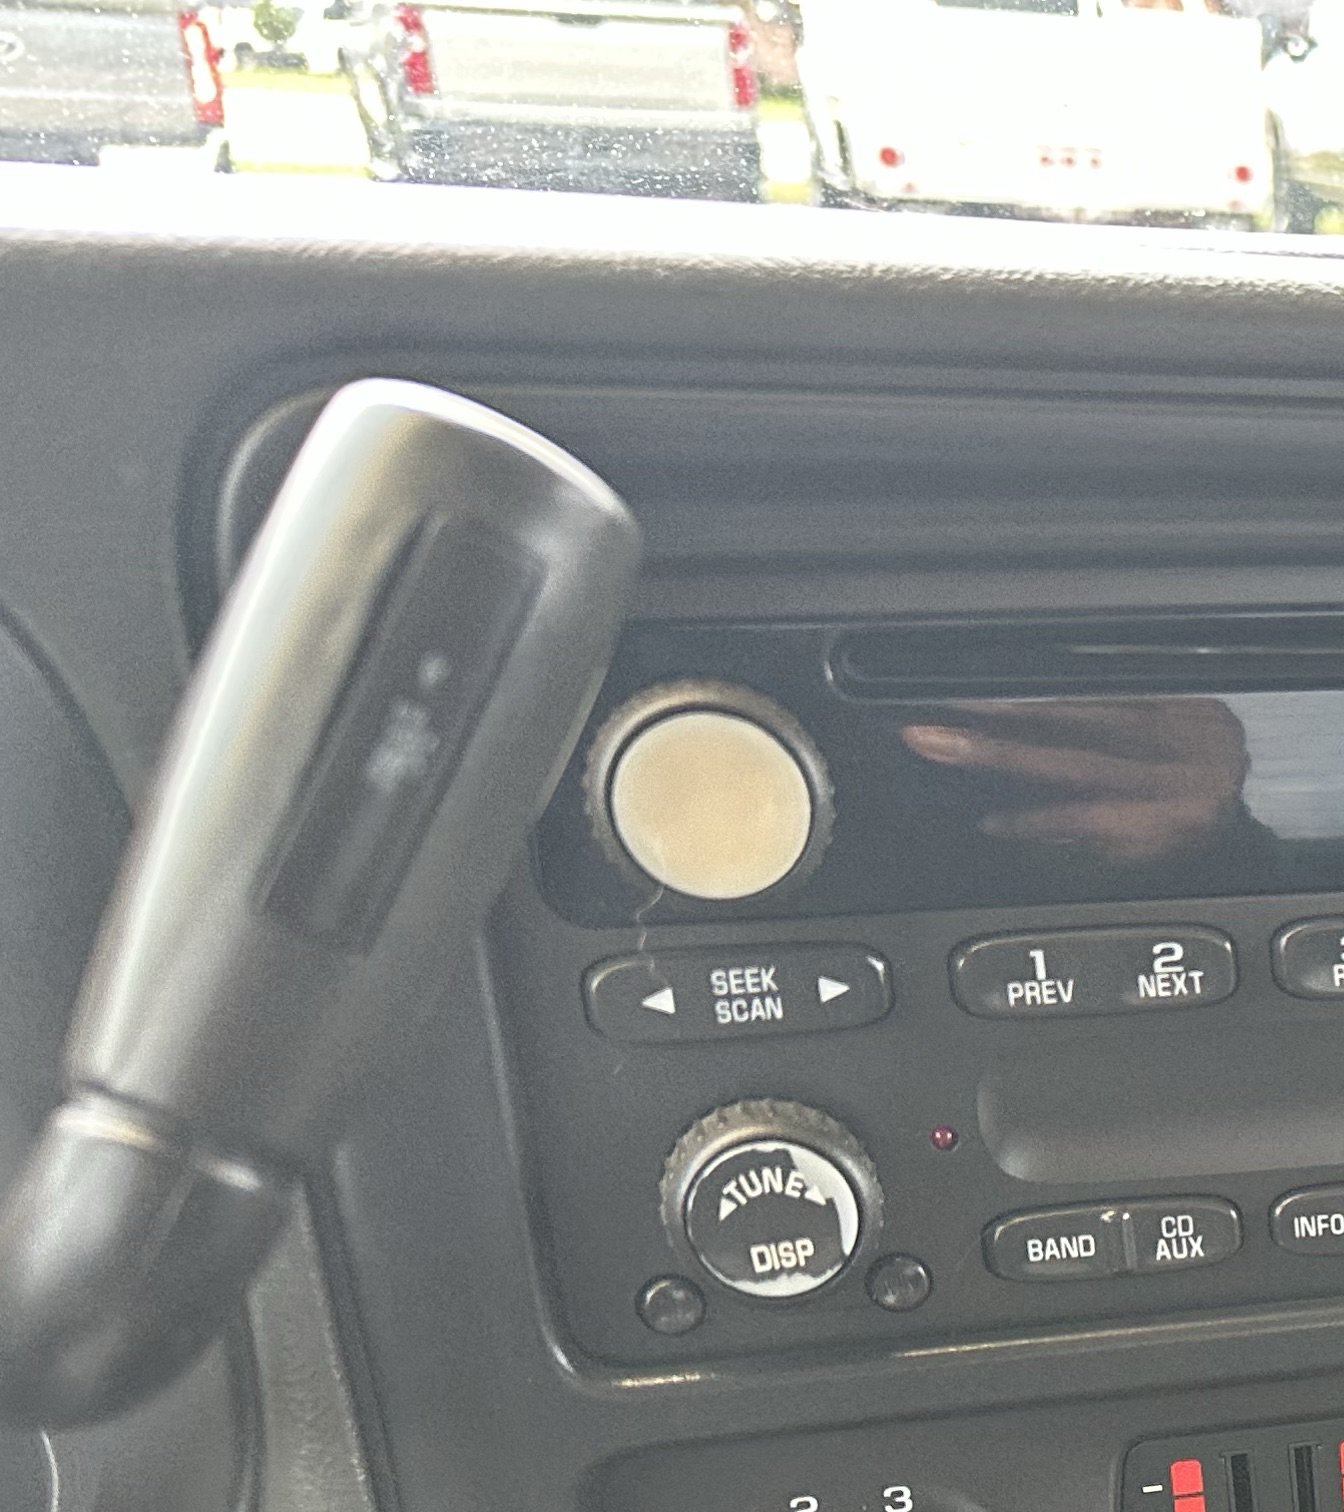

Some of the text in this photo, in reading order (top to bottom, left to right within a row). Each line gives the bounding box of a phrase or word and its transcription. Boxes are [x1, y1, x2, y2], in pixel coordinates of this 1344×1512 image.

[1029, 950, 1047, 980] 1
[1152, 942, 1185, 973] 2
[710, 966, 779, 996] SEEK
[1007, 979, 1074, 1007] PREV
[1137, 971, 1204, 998] NEXT
[715, 996, 784, 1024] SCAN
[722, 1167, 805, 1206] TUNE
[1160, 1215, 1194, 1238] CD
[750, 1238, 815, 1273] DISP
[1027, 1234, 1096, 1262] BAND
[1155, 1237, 1205, 1261] AUX
